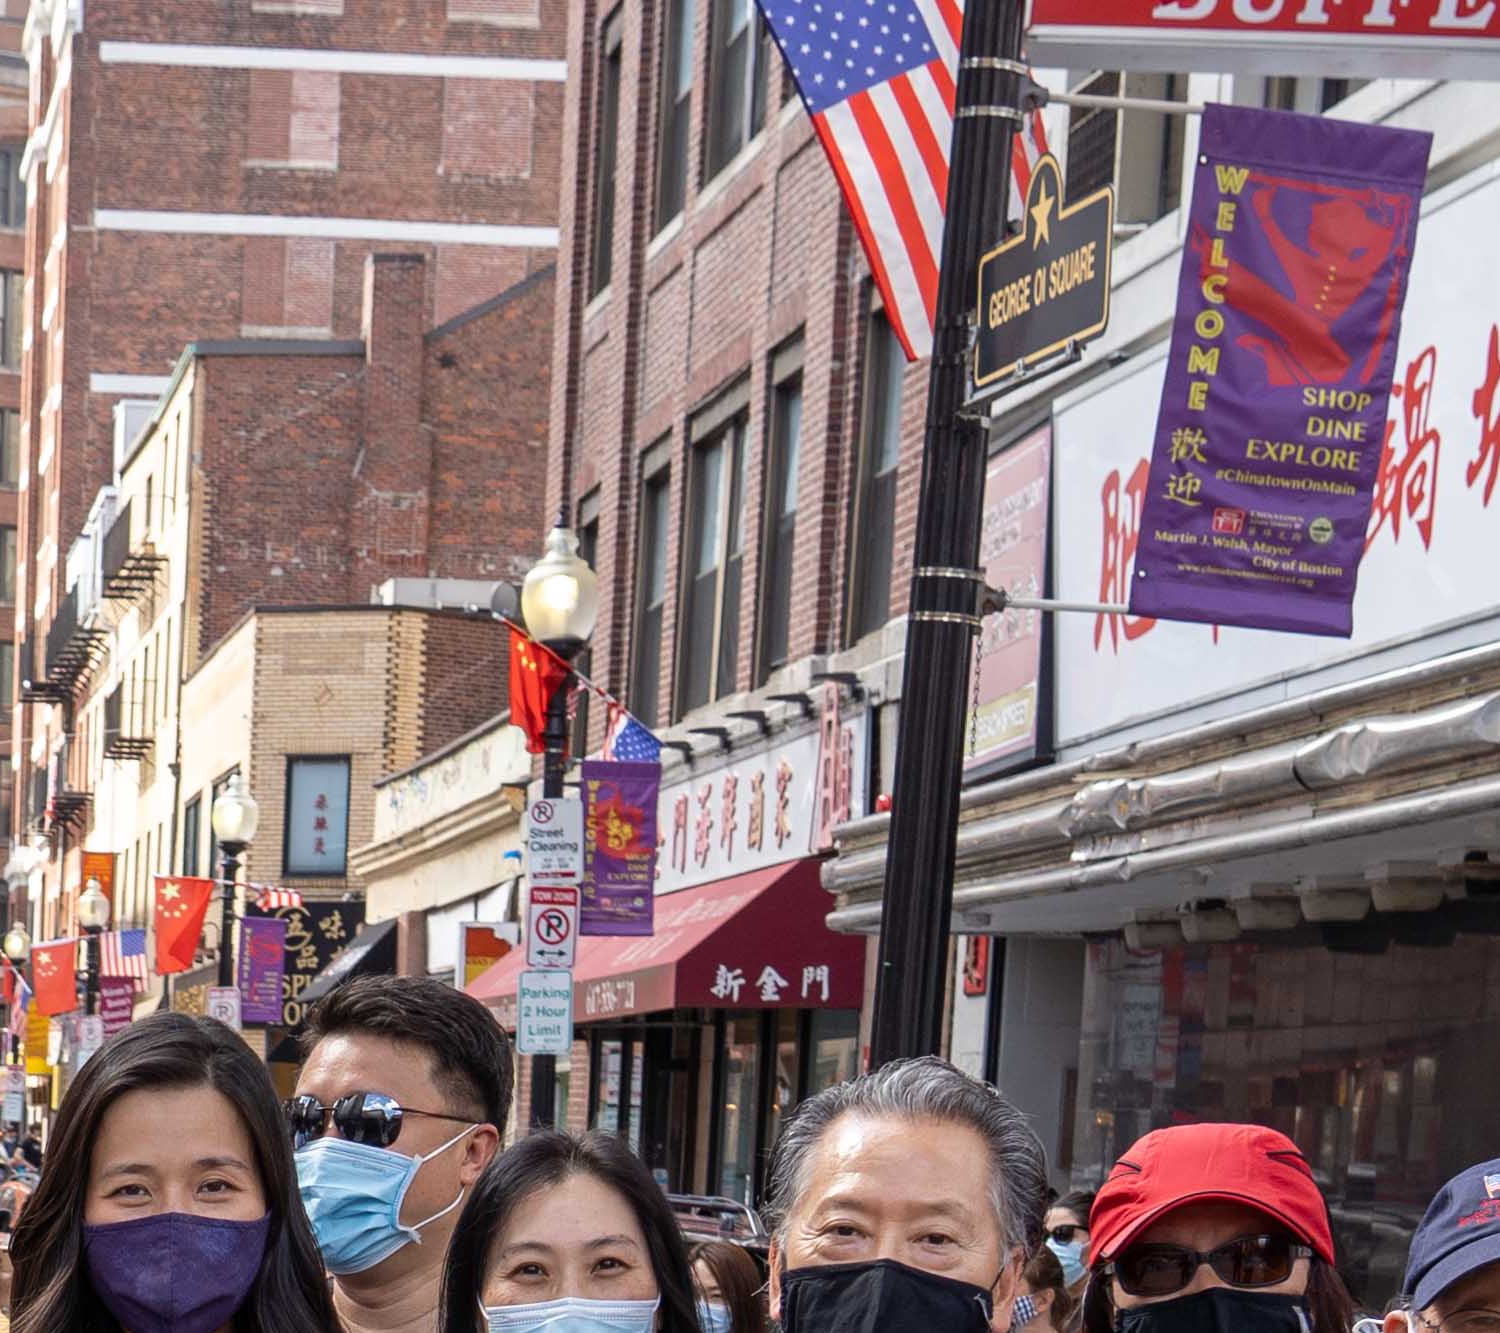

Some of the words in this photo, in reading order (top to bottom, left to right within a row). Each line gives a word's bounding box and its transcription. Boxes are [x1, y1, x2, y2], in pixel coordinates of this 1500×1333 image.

[988, 273, 1032, 330] GEORGE
[1033, 266, 1047, 306] OI
[1048, 241, 1096, 300] SQUARE
[1187, 165, 1250, 412] WELCOME
[1303, 387, 1371, 412] SHOP
[1306, 416, 1368, 442] DINE
[1162, 427, 1209, 507] 歡迎
[1246, 439, 1361, 471] EXPLORE
[1215, 468, 1356, 496] #ChinatownOnMain
[1155, 529, 1197, 545] Martin
[1213, 534, 1250, 552] Walsh,
[1253, 540, 1293, 556] Mayor
[1252, 555, 1278, 571] City
[1282, 557, 1297, 571] of
[1299, 560, 1342, 577] Boston
[529, 827, 564, 839] Street
[529, 839, 579, 854] Cleaning
[521, 987, 570, 1001] Parking
[709, 963, 830, 1003] 新金門
[524, 1006, 533, 1018] 2
[536, 1005, 567, 1018] Hour
[528, 1023, 562, 1036] Limit
